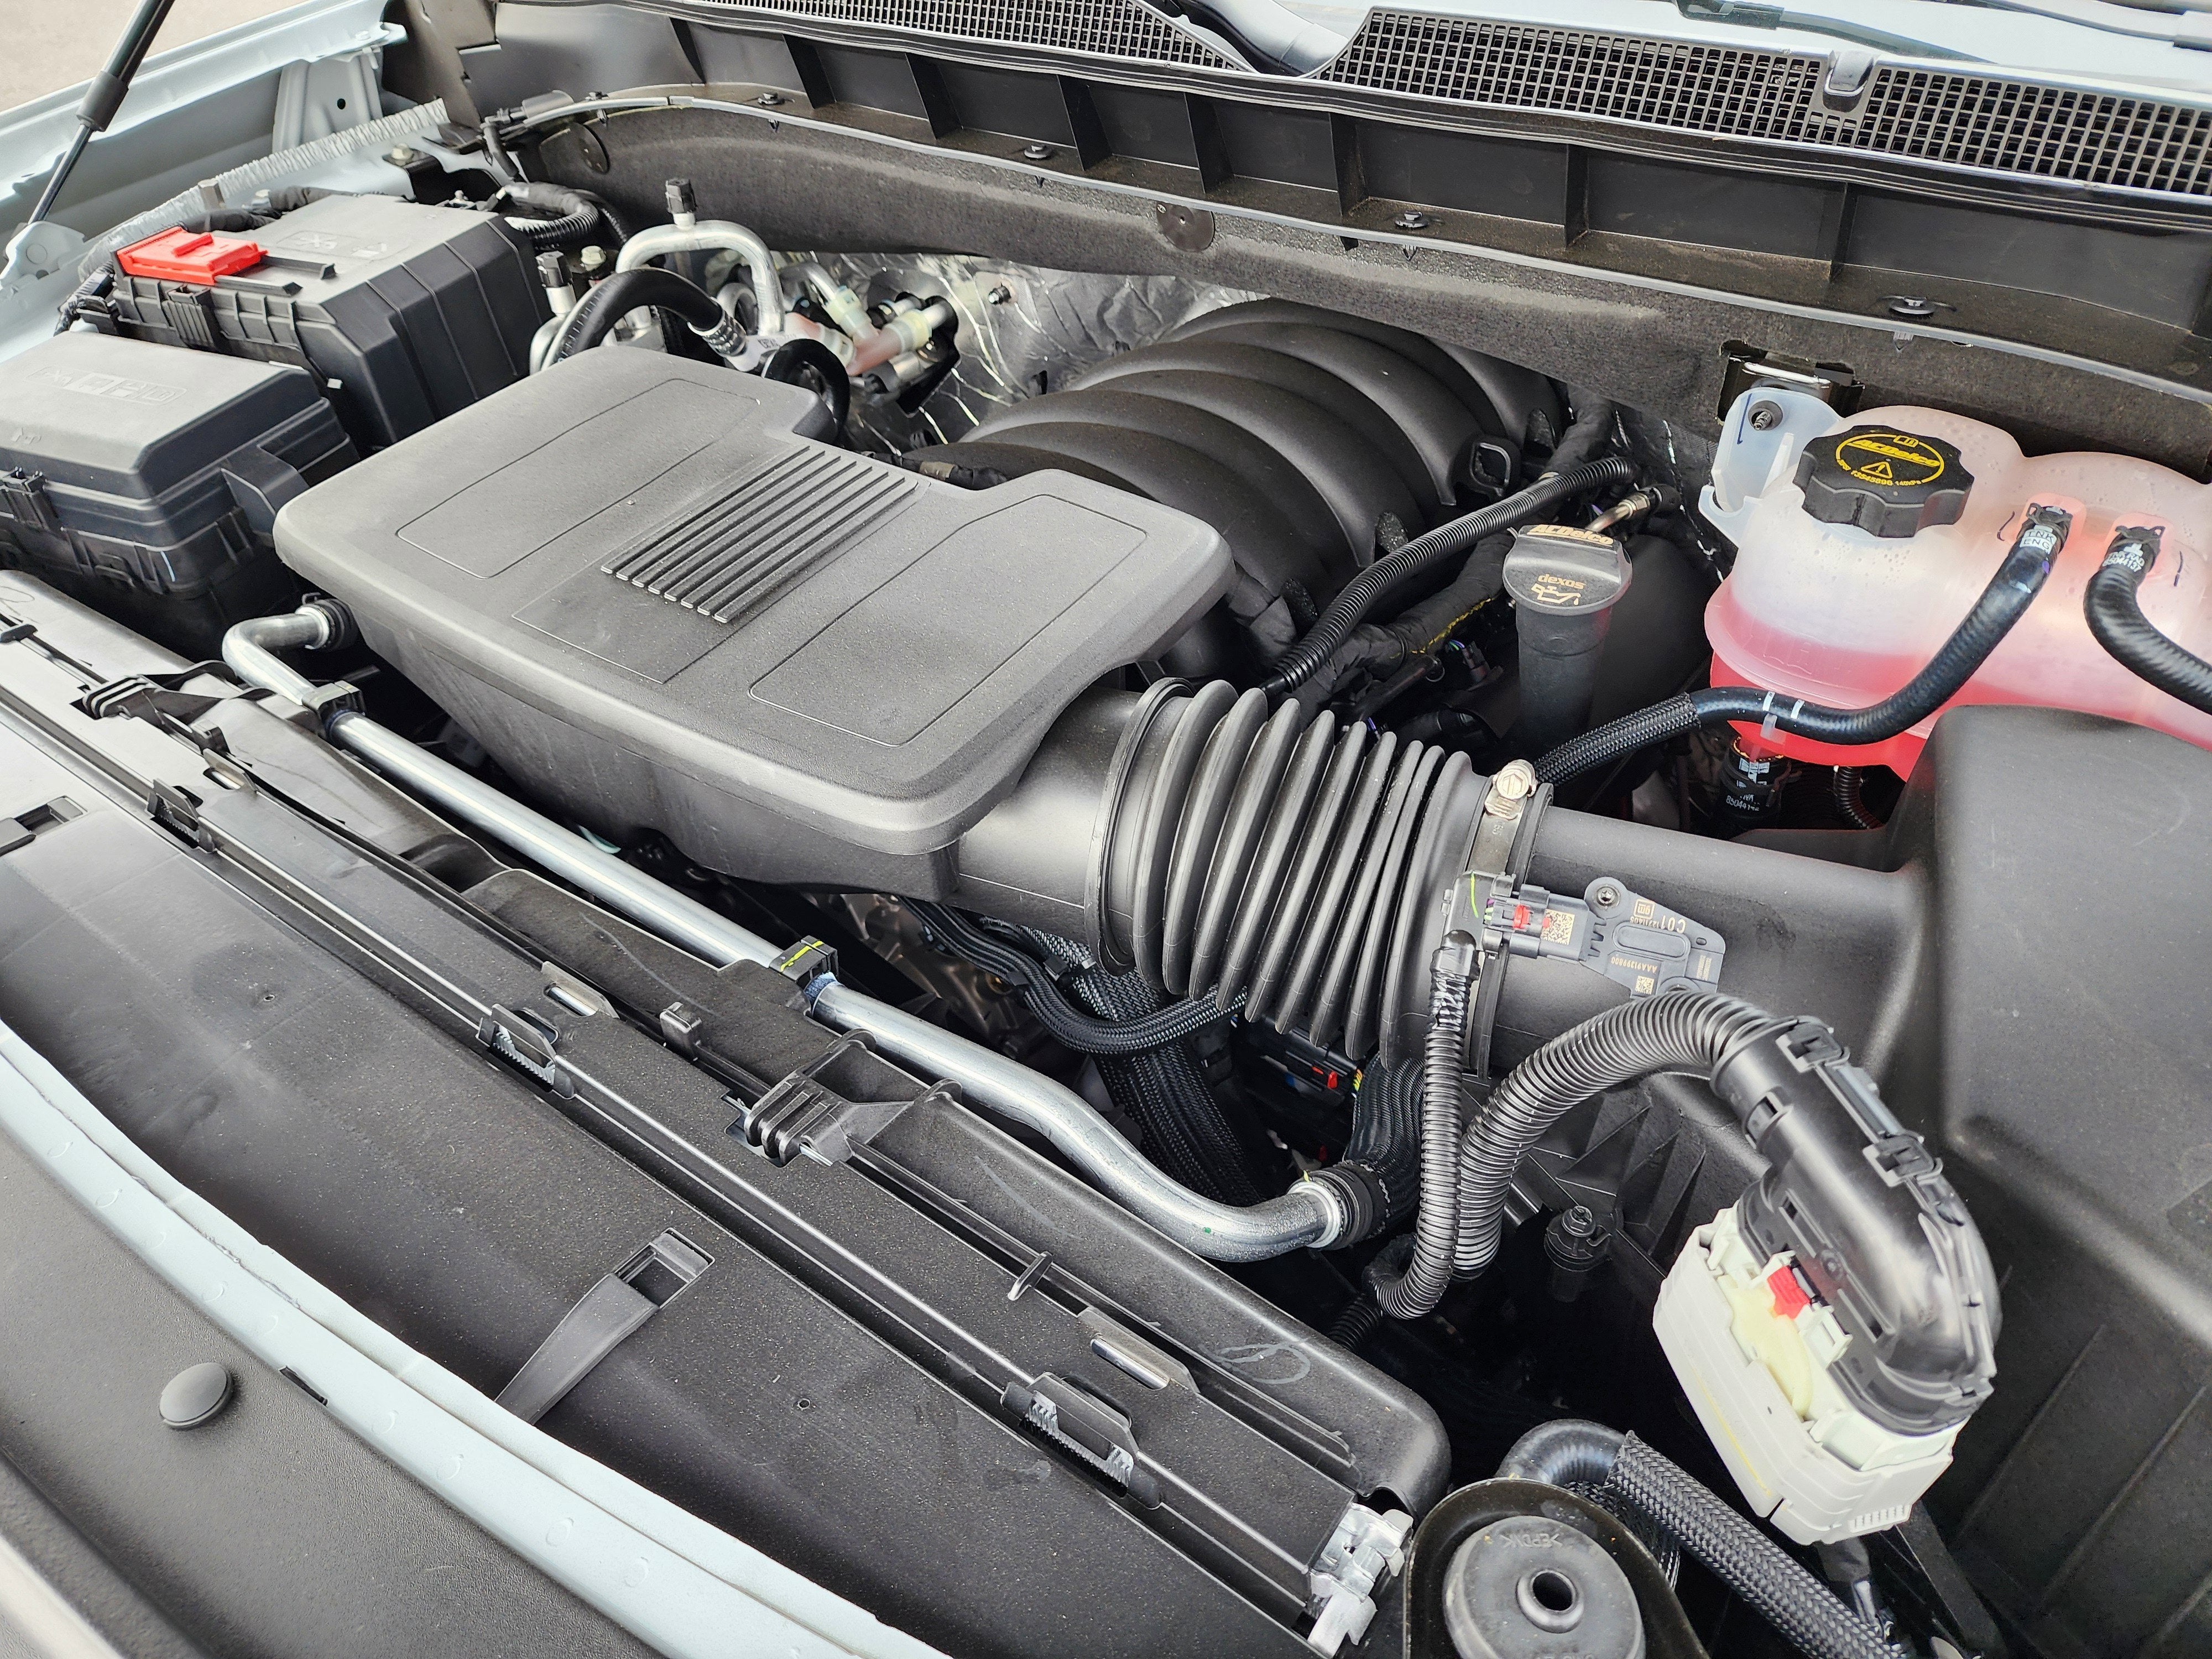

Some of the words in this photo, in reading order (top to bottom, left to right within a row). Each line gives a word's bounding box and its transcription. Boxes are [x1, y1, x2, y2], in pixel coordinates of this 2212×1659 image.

[1852, 440, 1940, 466] ACDelco
[1528, 524, 1614, 545] ACDelco
[2028, 530, 2054, 545] TNK
[2023, 539, 2050, 550] ENG
[1538, 573, 1586, 589] dexos
